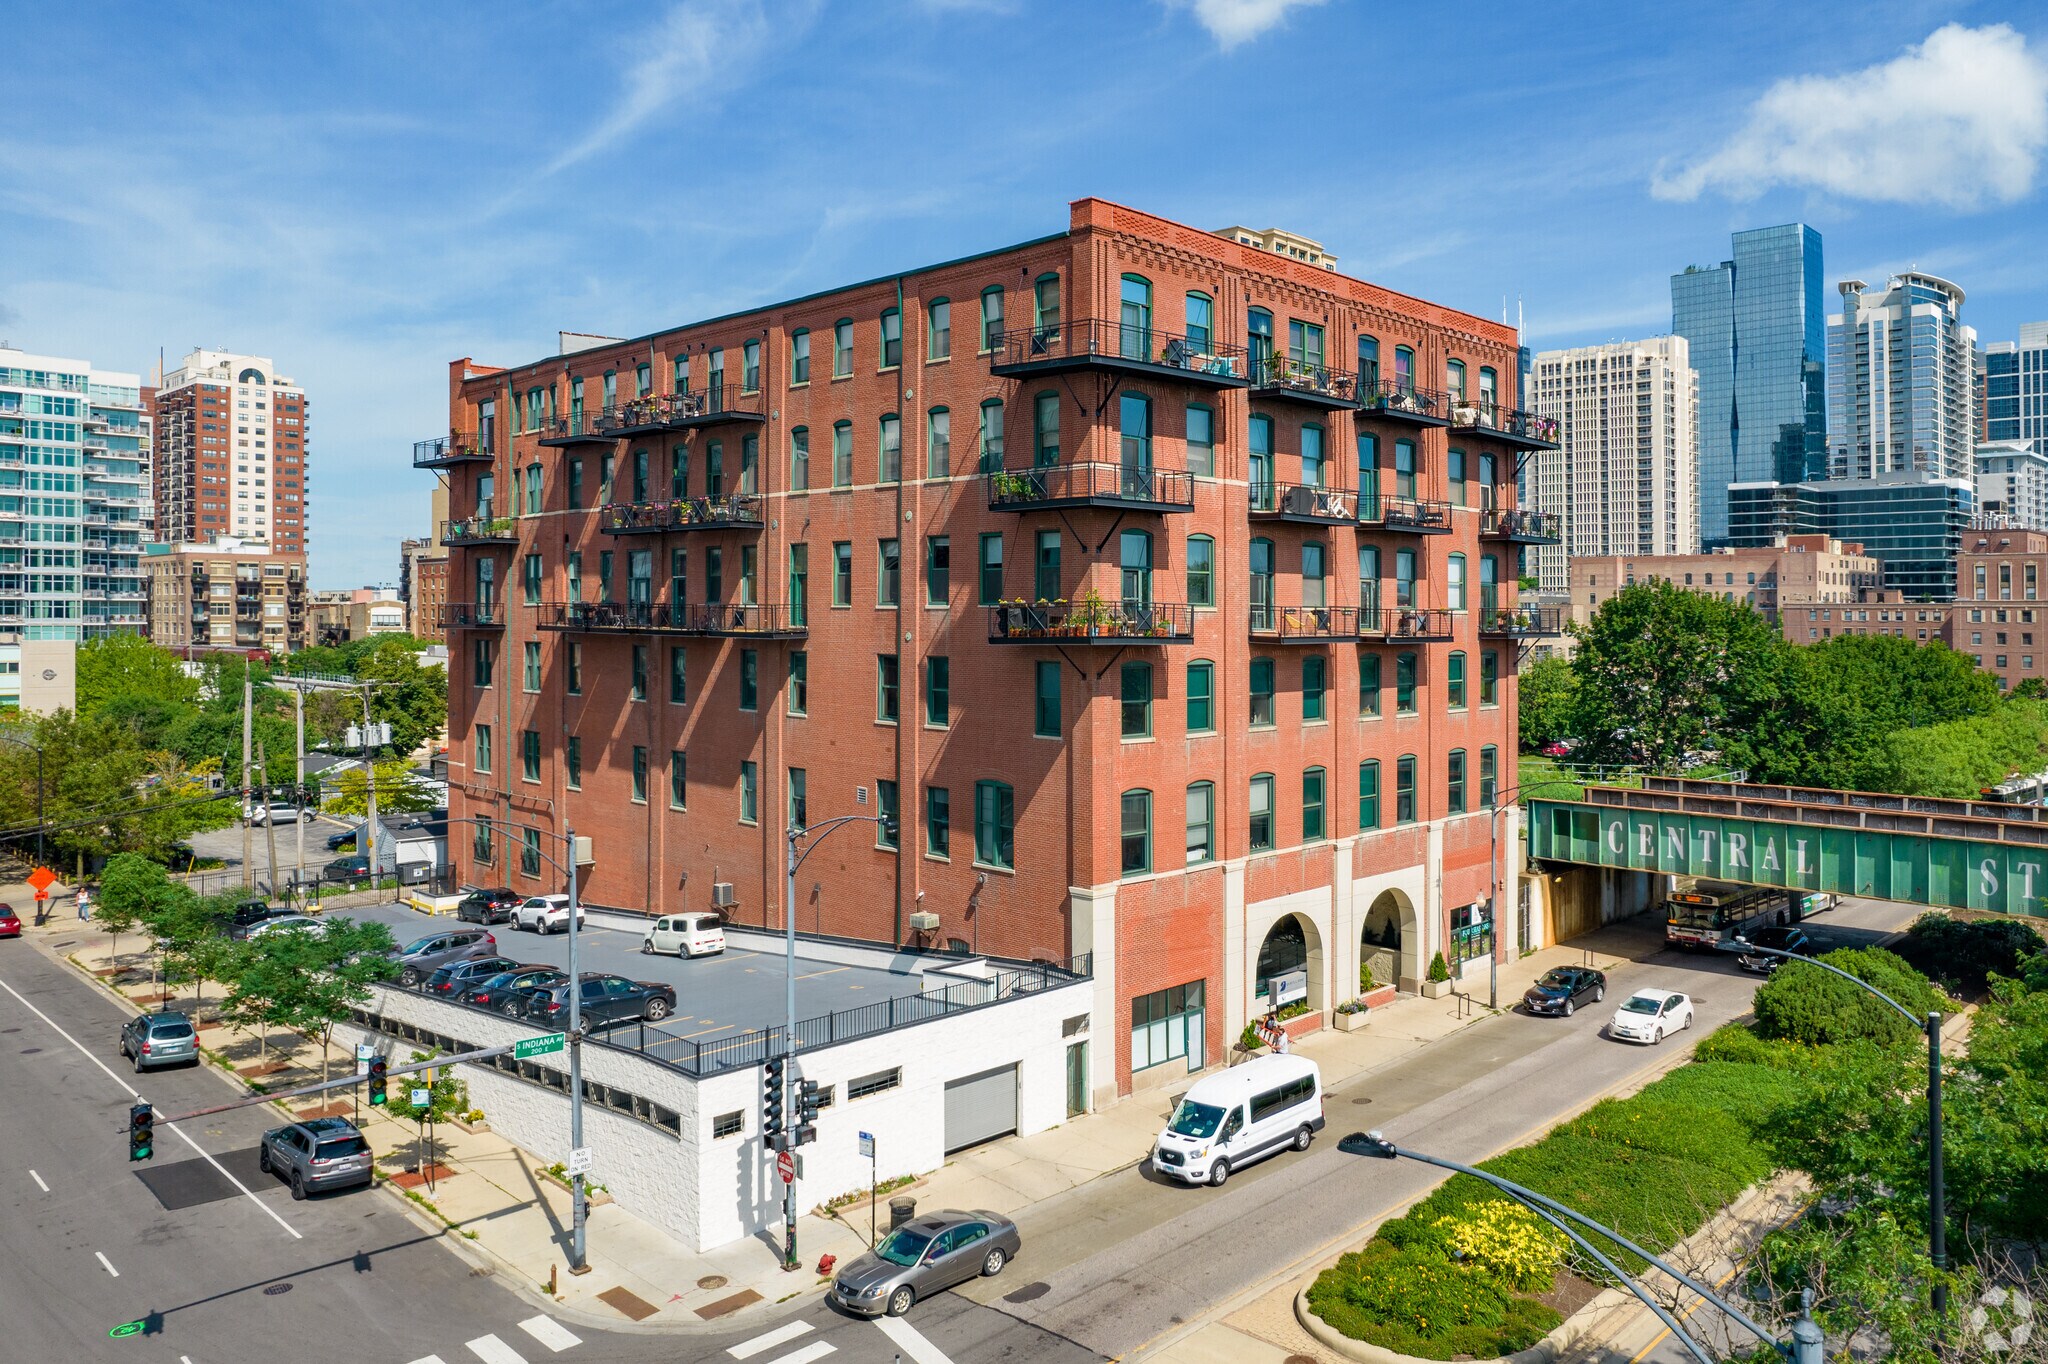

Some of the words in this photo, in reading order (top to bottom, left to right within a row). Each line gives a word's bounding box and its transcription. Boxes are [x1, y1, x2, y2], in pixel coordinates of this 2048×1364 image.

[1607, 820, 1814, 875] CENTRAL
[522, 1036, 555, 1050] INDIANA
[574, 1157, 588, 1165] TURN
[581, 1163, 592, 1171] RED
